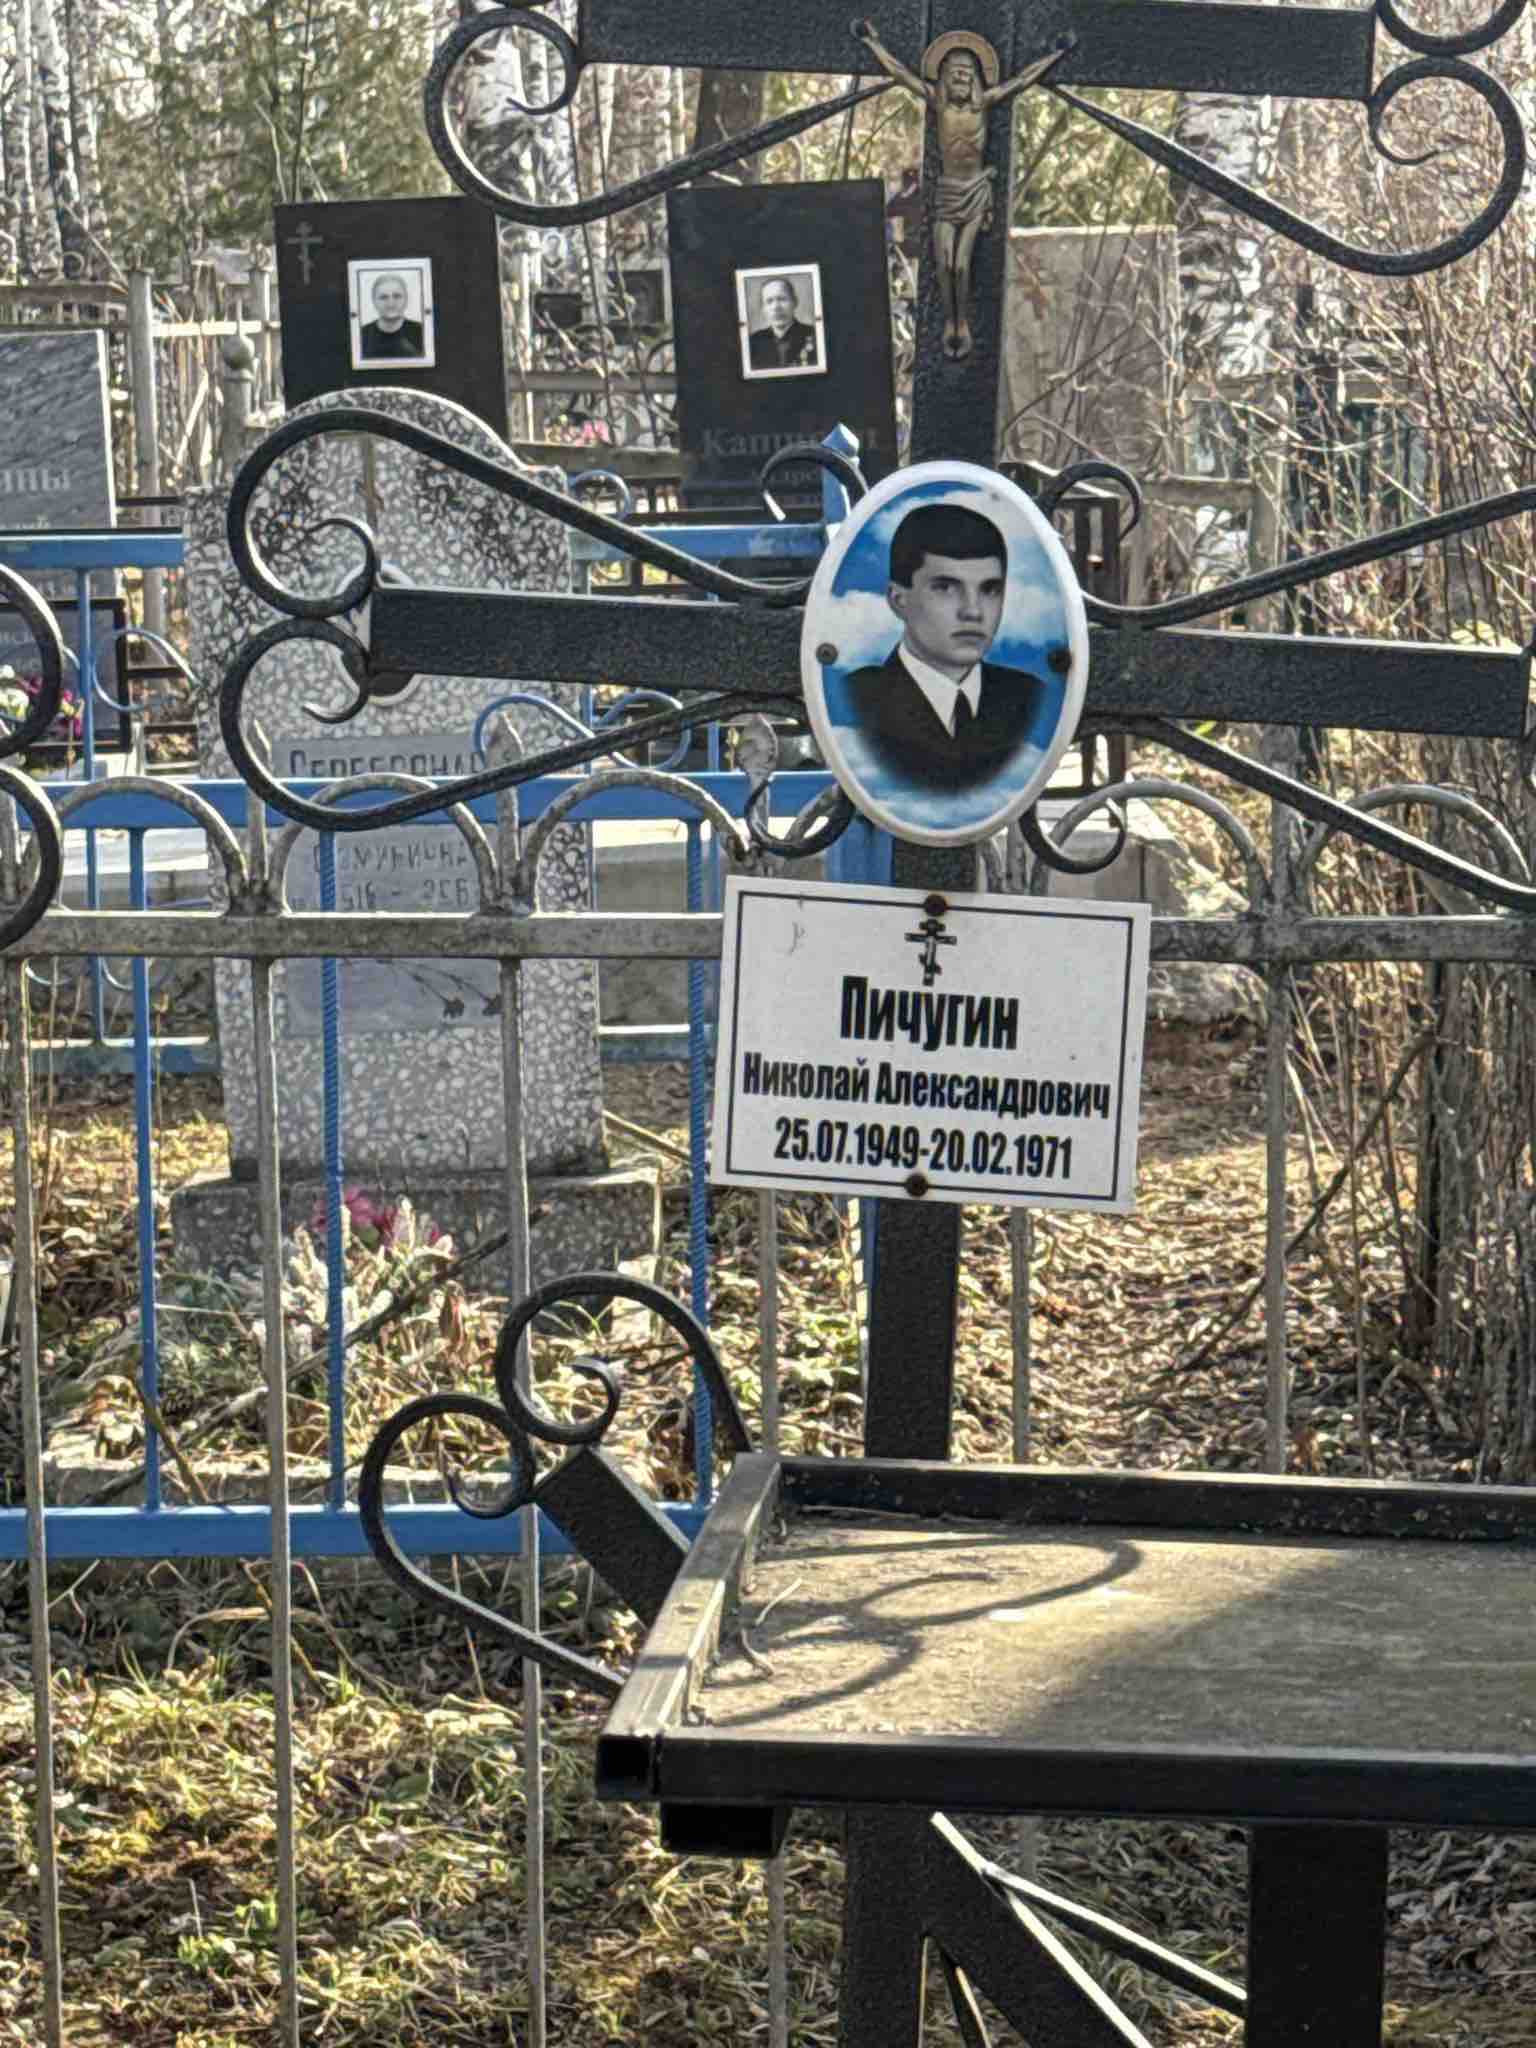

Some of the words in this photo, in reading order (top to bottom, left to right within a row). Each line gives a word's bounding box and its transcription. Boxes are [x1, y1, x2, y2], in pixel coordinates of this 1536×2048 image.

[840, 975, 1019, 1051] Пичугин
[742, 1052, 870, 1104] Николай
[874, 1062, 1110, 1119] Александрович
[773, 1117, 1072, 1179] 25.07.1949-20.02.1971
